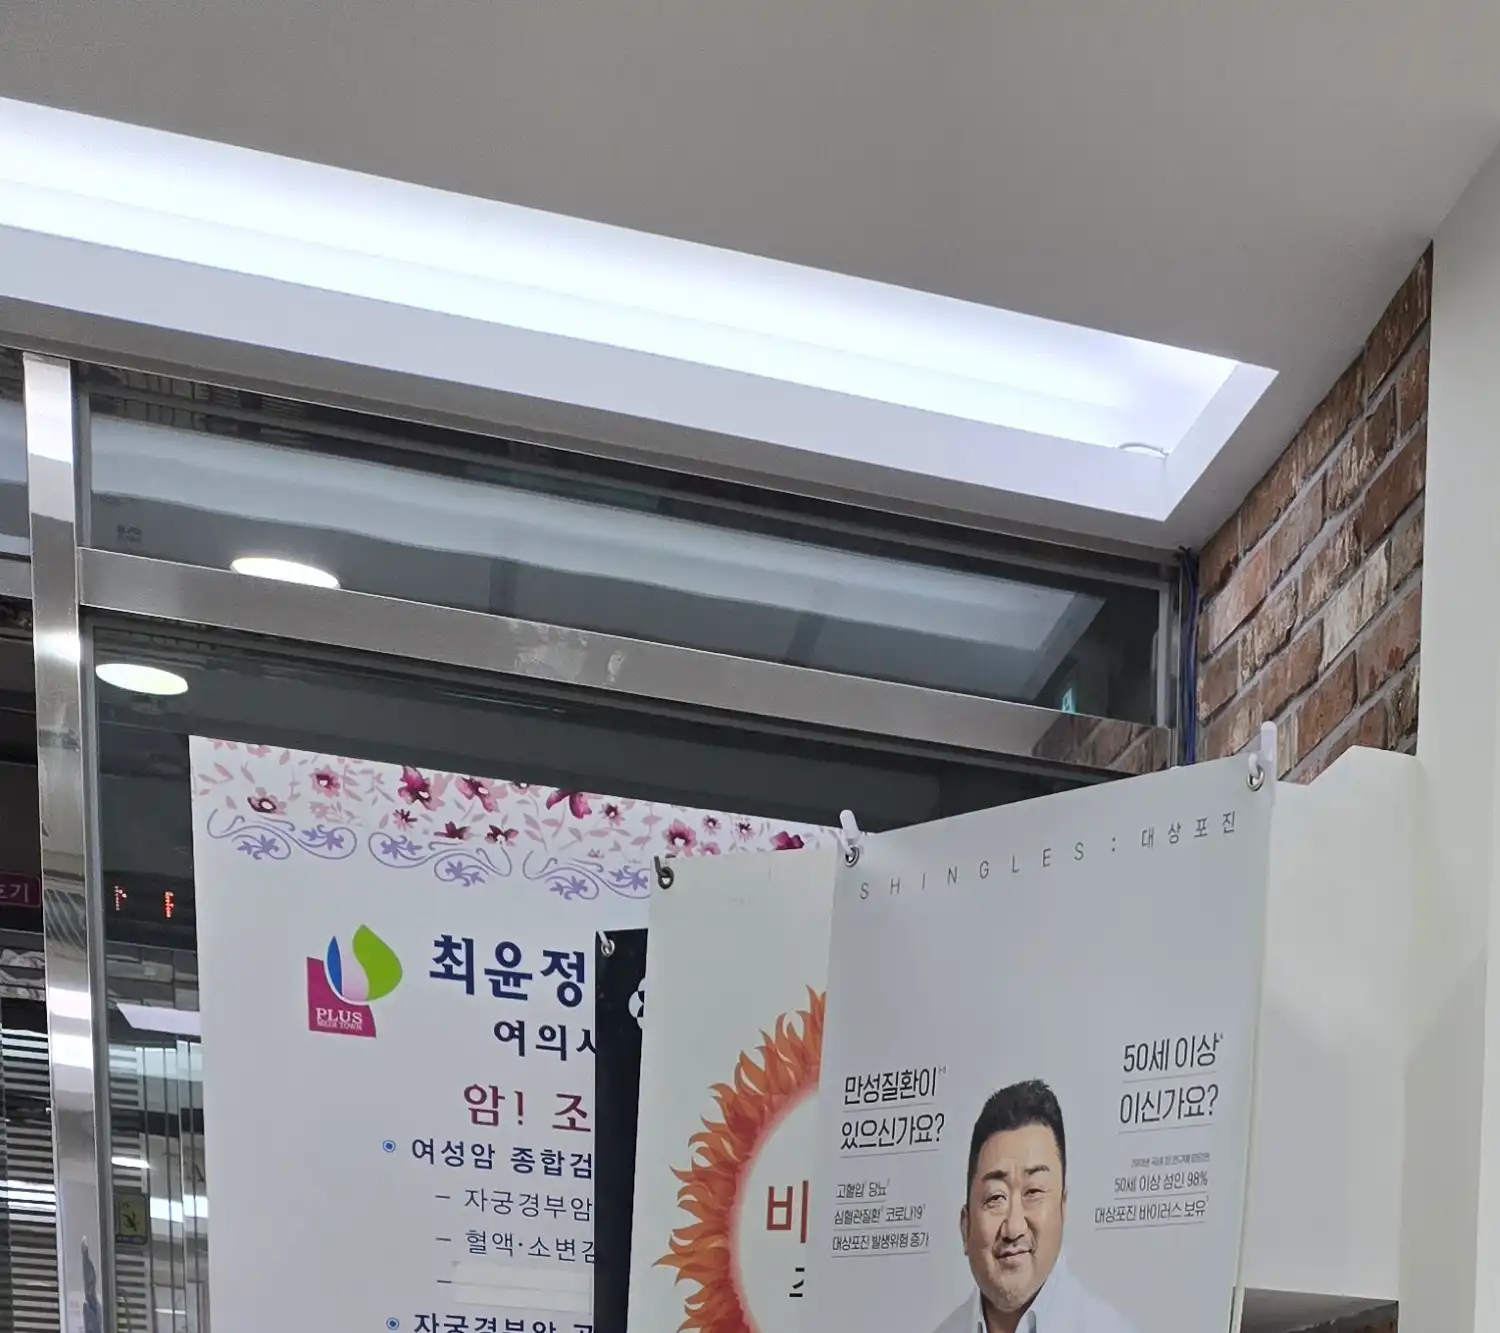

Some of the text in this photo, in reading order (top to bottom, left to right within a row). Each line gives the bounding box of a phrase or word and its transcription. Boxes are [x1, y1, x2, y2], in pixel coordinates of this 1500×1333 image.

[429, 934, 586, 1008] 최윤정
[315, 1007, 362, 1024] PLUS
[1123, 1037, 1171, 1072] 50세
[464, 1084, 592, 1133] 암! 조
[1119, 1083, 1219, 1125] 이신가요?
[840, 1113, 945, 1150] 있으신가요?
[412, 1138, 593, 1180] 여성암 종합검
[1114, 1176, 1137, 1193] 50세
[1139, 1174, 1161, 1192] 이상
[1187, 1170, 1208, 1187] 98%
[464, 1188, 593, 1222] 자궁경부암
[832, 1235, 870, 1252] 대상포진
